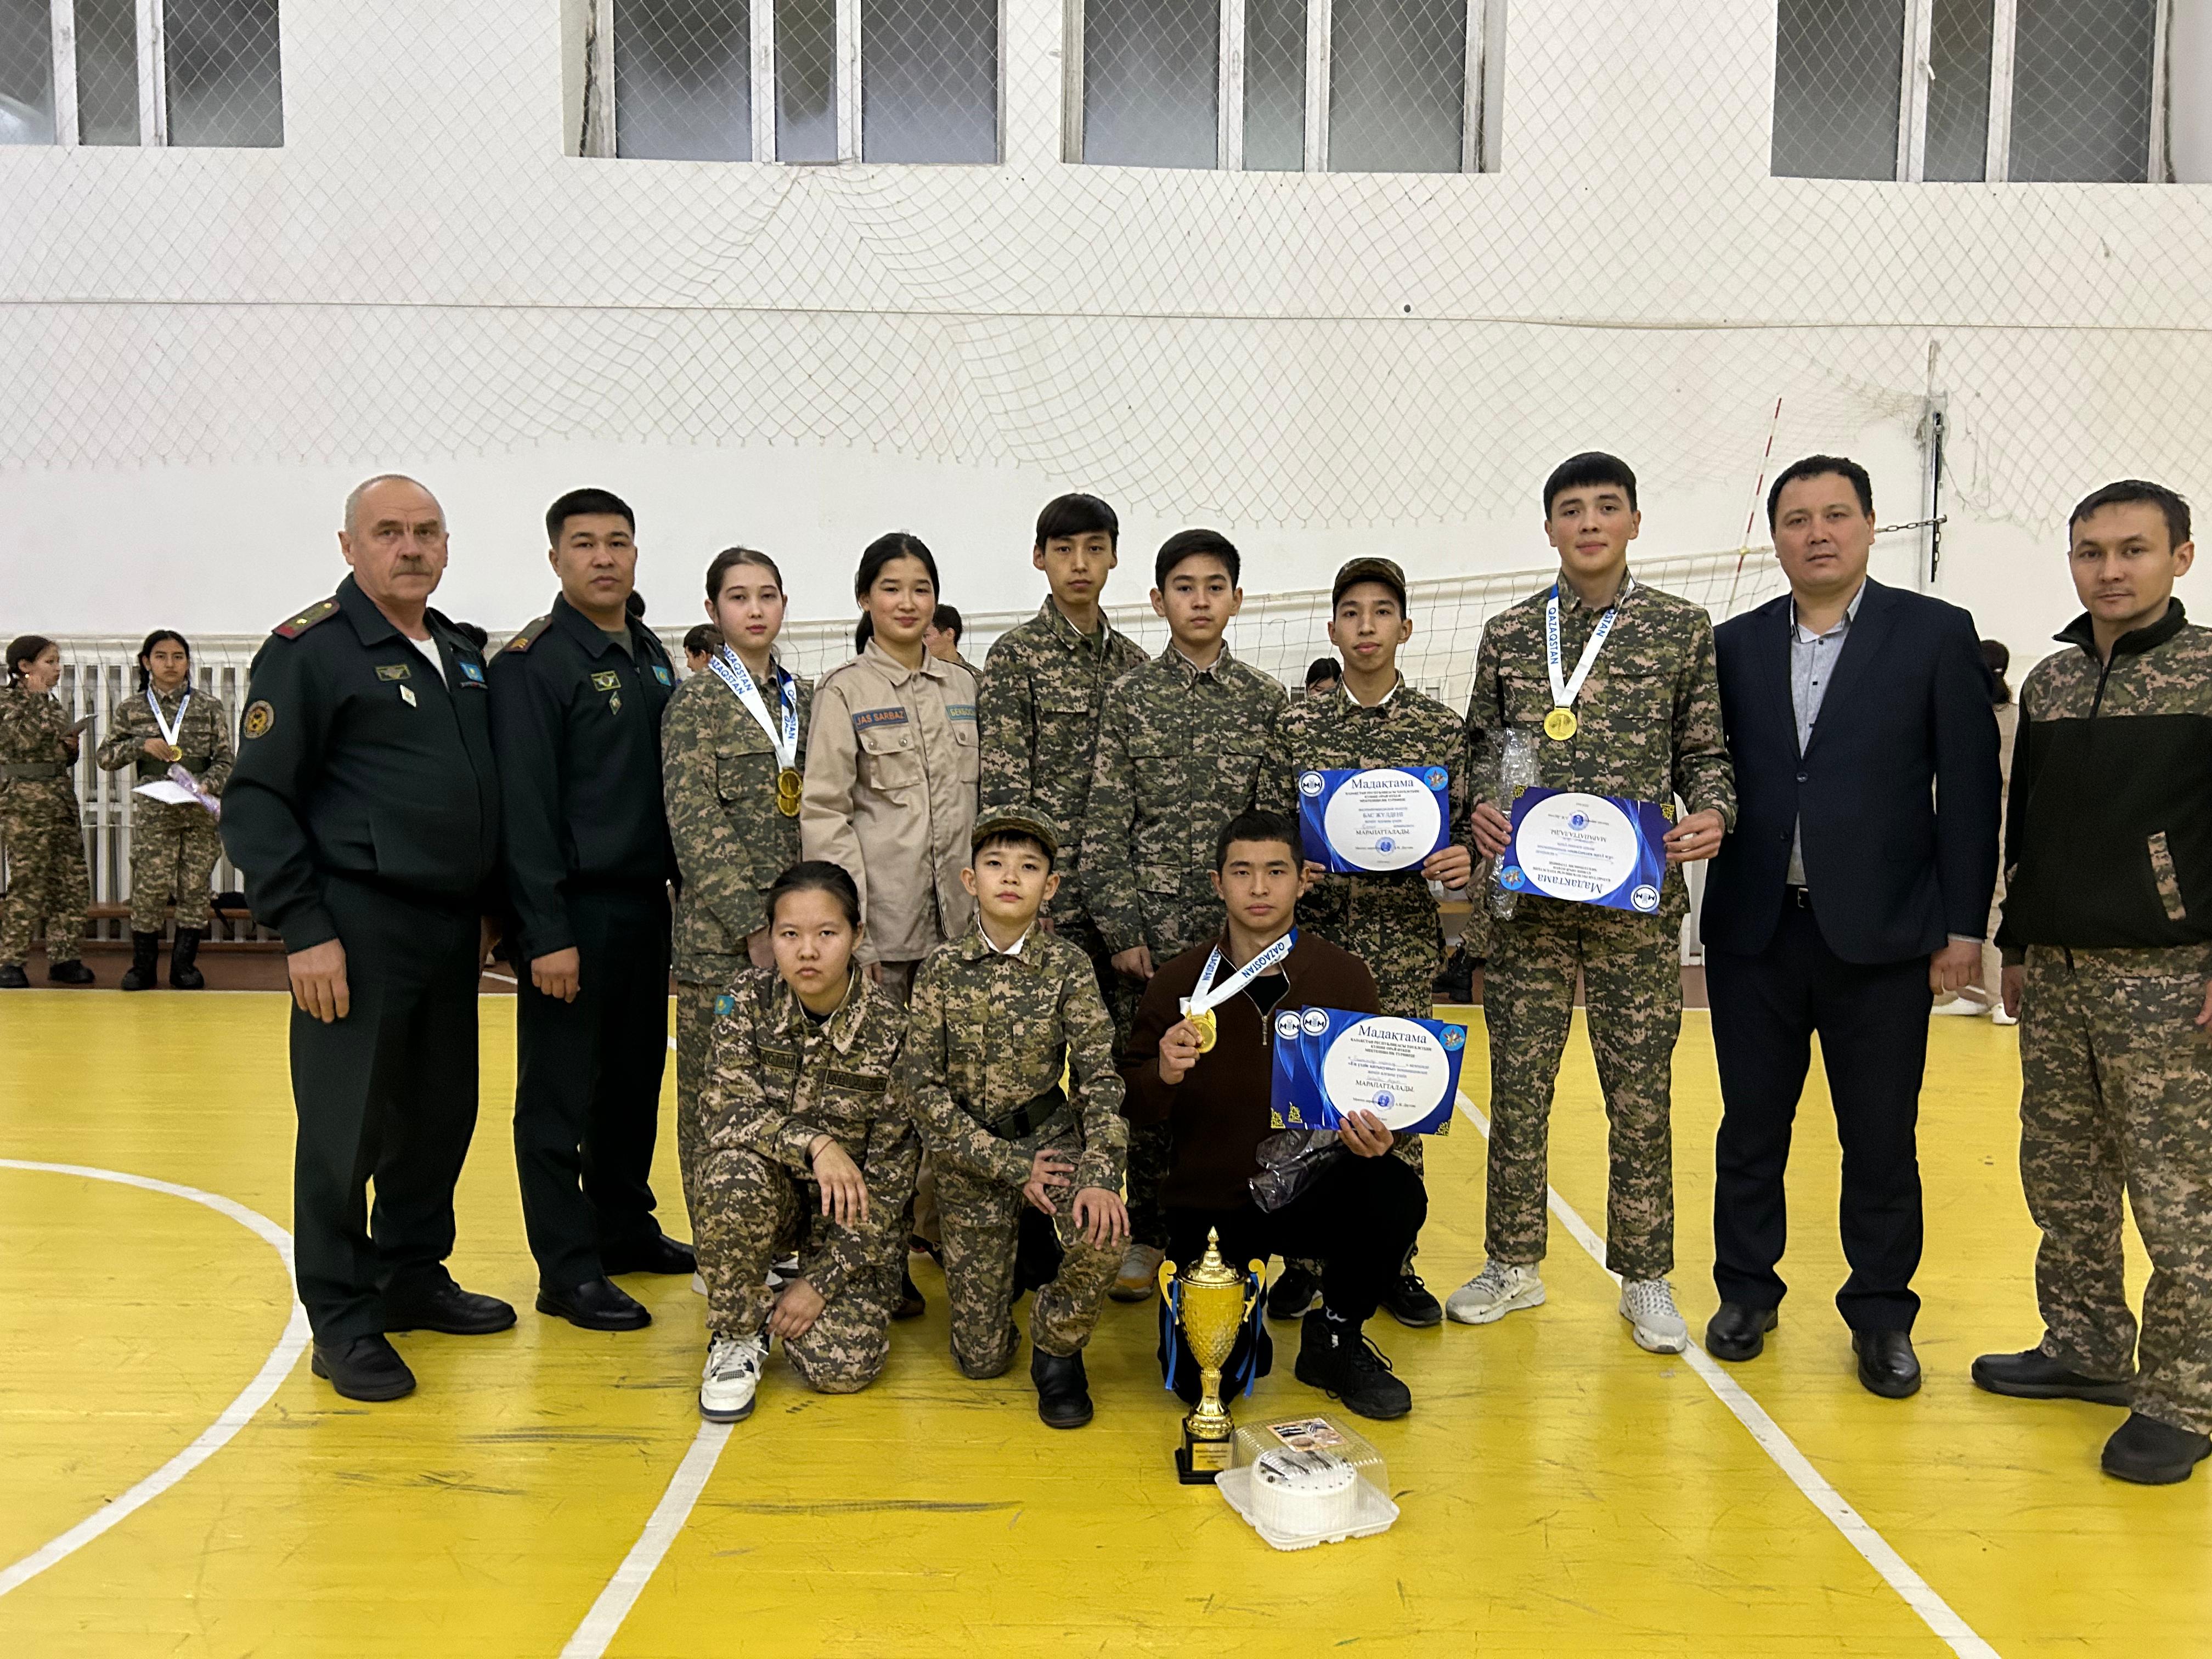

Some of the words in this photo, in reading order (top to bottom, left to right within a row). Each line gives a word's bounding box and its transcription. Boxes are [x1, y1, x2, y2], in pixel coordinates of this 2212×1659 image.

[1548, 606, 1559, 665] QAZAQSTAN
[857, 714, 872, 726] JAS
[873, 710, 905, 721] SARBAZ
[1241, 942, 1285, 978] QAZAQSTAN
[1358, 1025, 1427, 1043] Мадақтама
